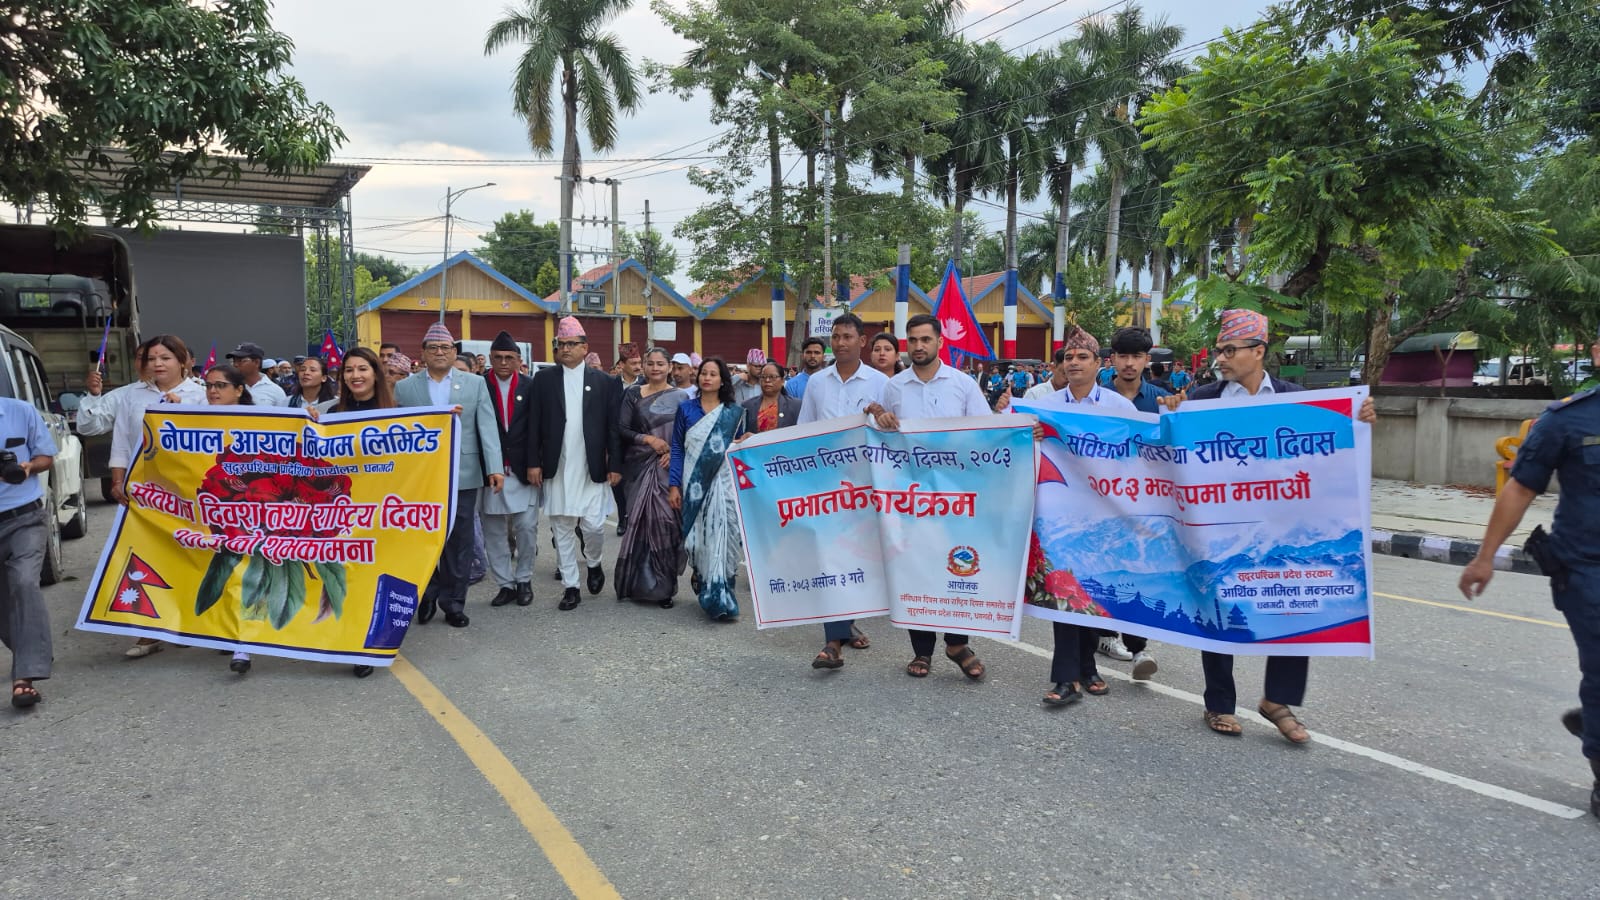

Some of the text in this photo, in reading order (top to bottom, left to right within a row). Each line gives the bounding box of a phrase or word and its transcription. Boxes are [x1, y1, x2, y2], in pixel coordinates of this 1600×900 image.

[159, 421, 442, 458] नेपाल आयल निगम लिमिटेड
[1194, 431, 1268, 466] राष्ट्रिय
[1275, 427, 1336, 458] दिवस
[314, 464, 359, 476] कार्यालय
[764, 455, 818, 477] संविधान
[818, 447, 857, 468] दिवस
[912, 446, 965, 470] दिवस,
[970, 447, 1011, 468] २०८३
[1087, 475, 1139, 502] २०८३
[131, 483, 442, 535] संविधान दिवश तथा राष्ट्रिय दिवश
[226, 530, 264, 554] को
[262, 537, 375, 565] शुभकामना
[769, 578, 786, 594] मिति
[792, 579, 809, 592] २०८३
[811, 572, 837, 589] असोज
[840, 574, 846, 587] ३
[848, 568, 865, 584] गते
[946, 578, 979, 591] आयोजक
[1283, 569, 1302, 579] प्रदेश
[1304, 569, 1333, 579] सरकार
[1220, 583, 1355, 598] आर्थिक मामिला मन्त्रालय
